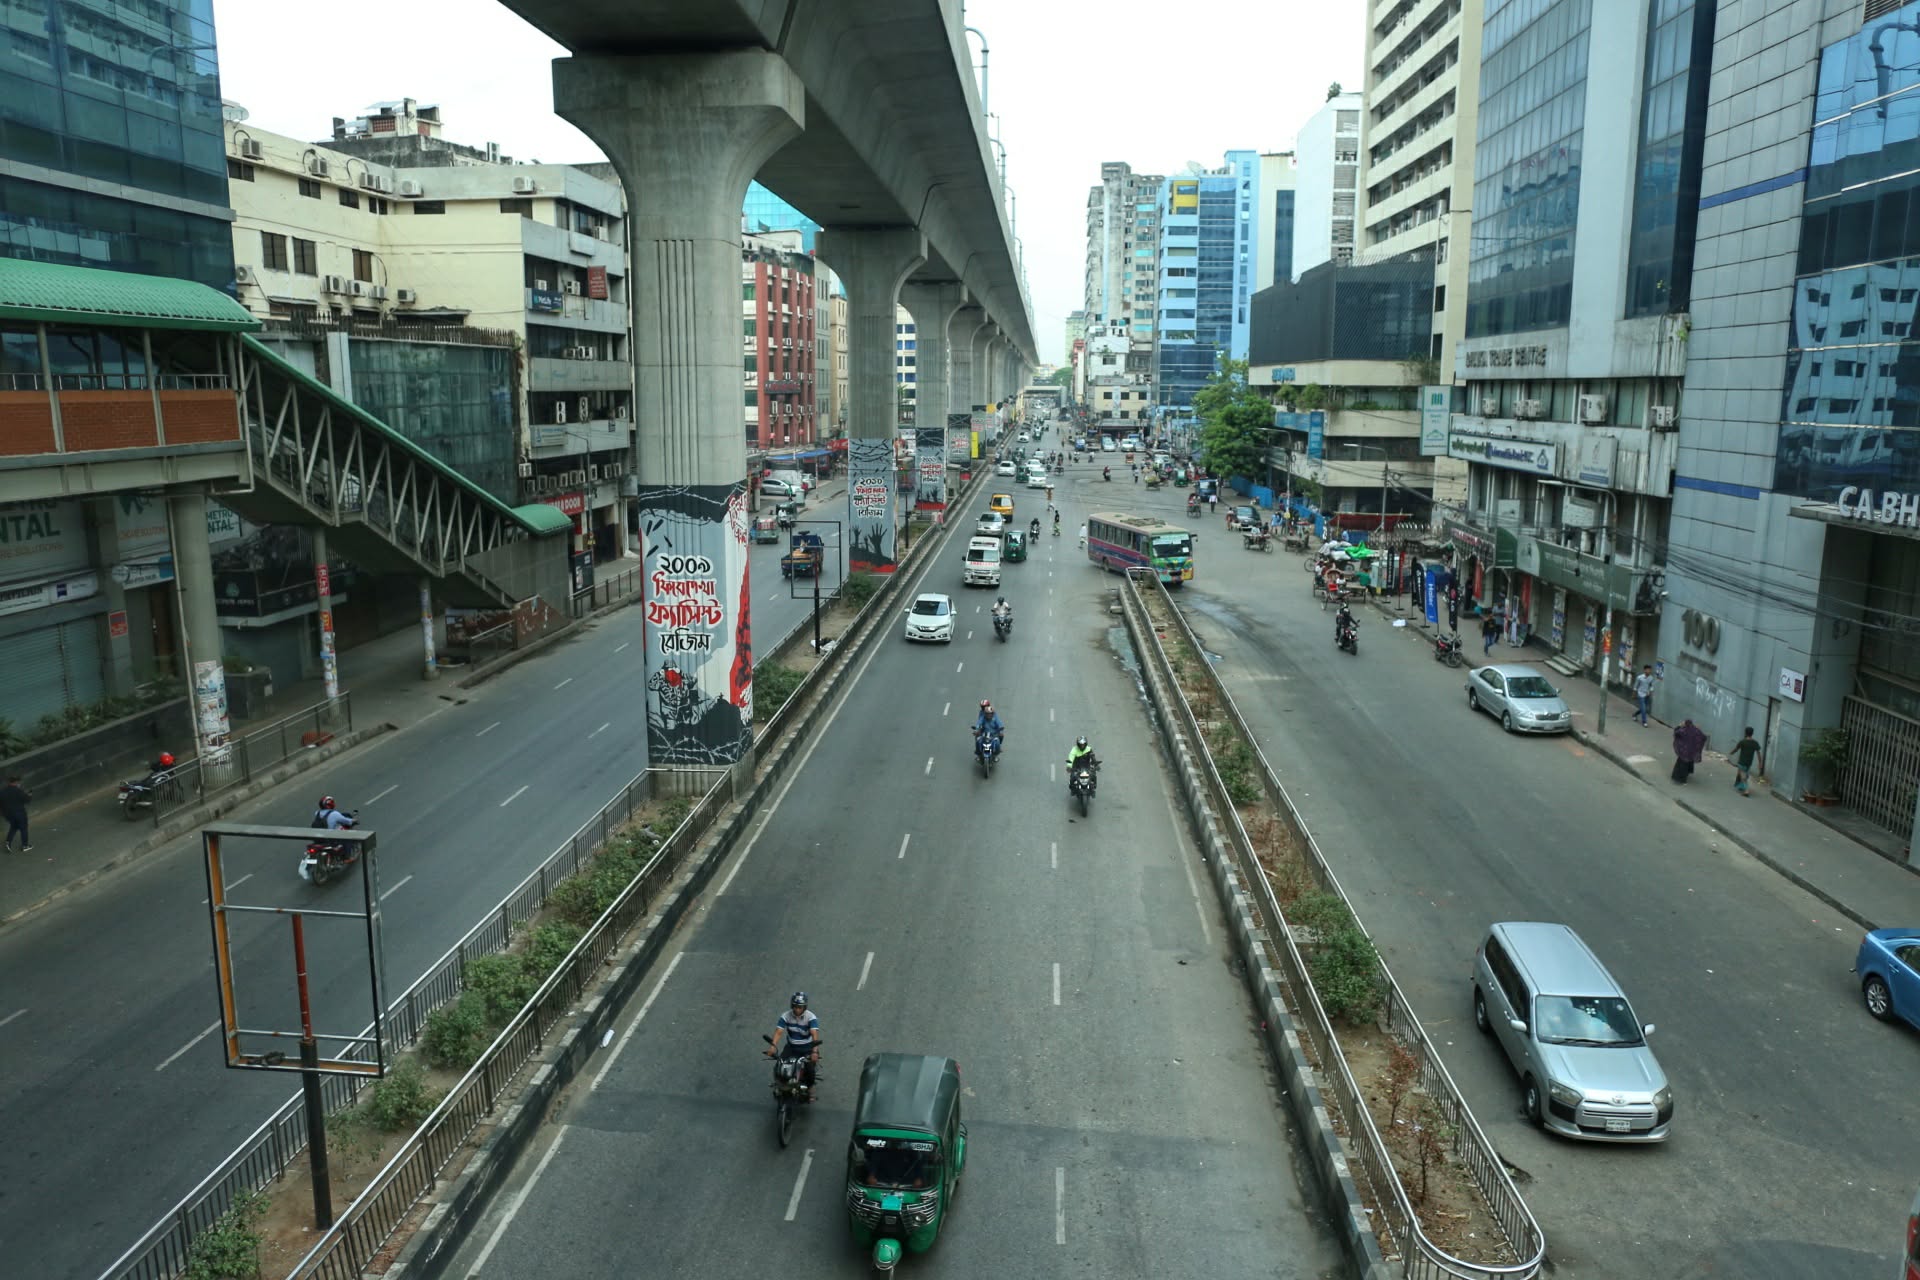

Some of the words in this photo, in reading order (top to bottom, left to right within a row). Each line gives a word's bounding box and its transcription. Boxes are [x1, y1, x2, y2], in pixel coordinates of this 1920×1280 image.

[1839, 486, 1873, 521] CA
[660, 556, 711, 574] ২০০৯
[648, 599, 722, 629] ফ্যাসিস্ট
[661, 627, 711, 654] রেজিম
[1681, 608, 1720, 655] 100
